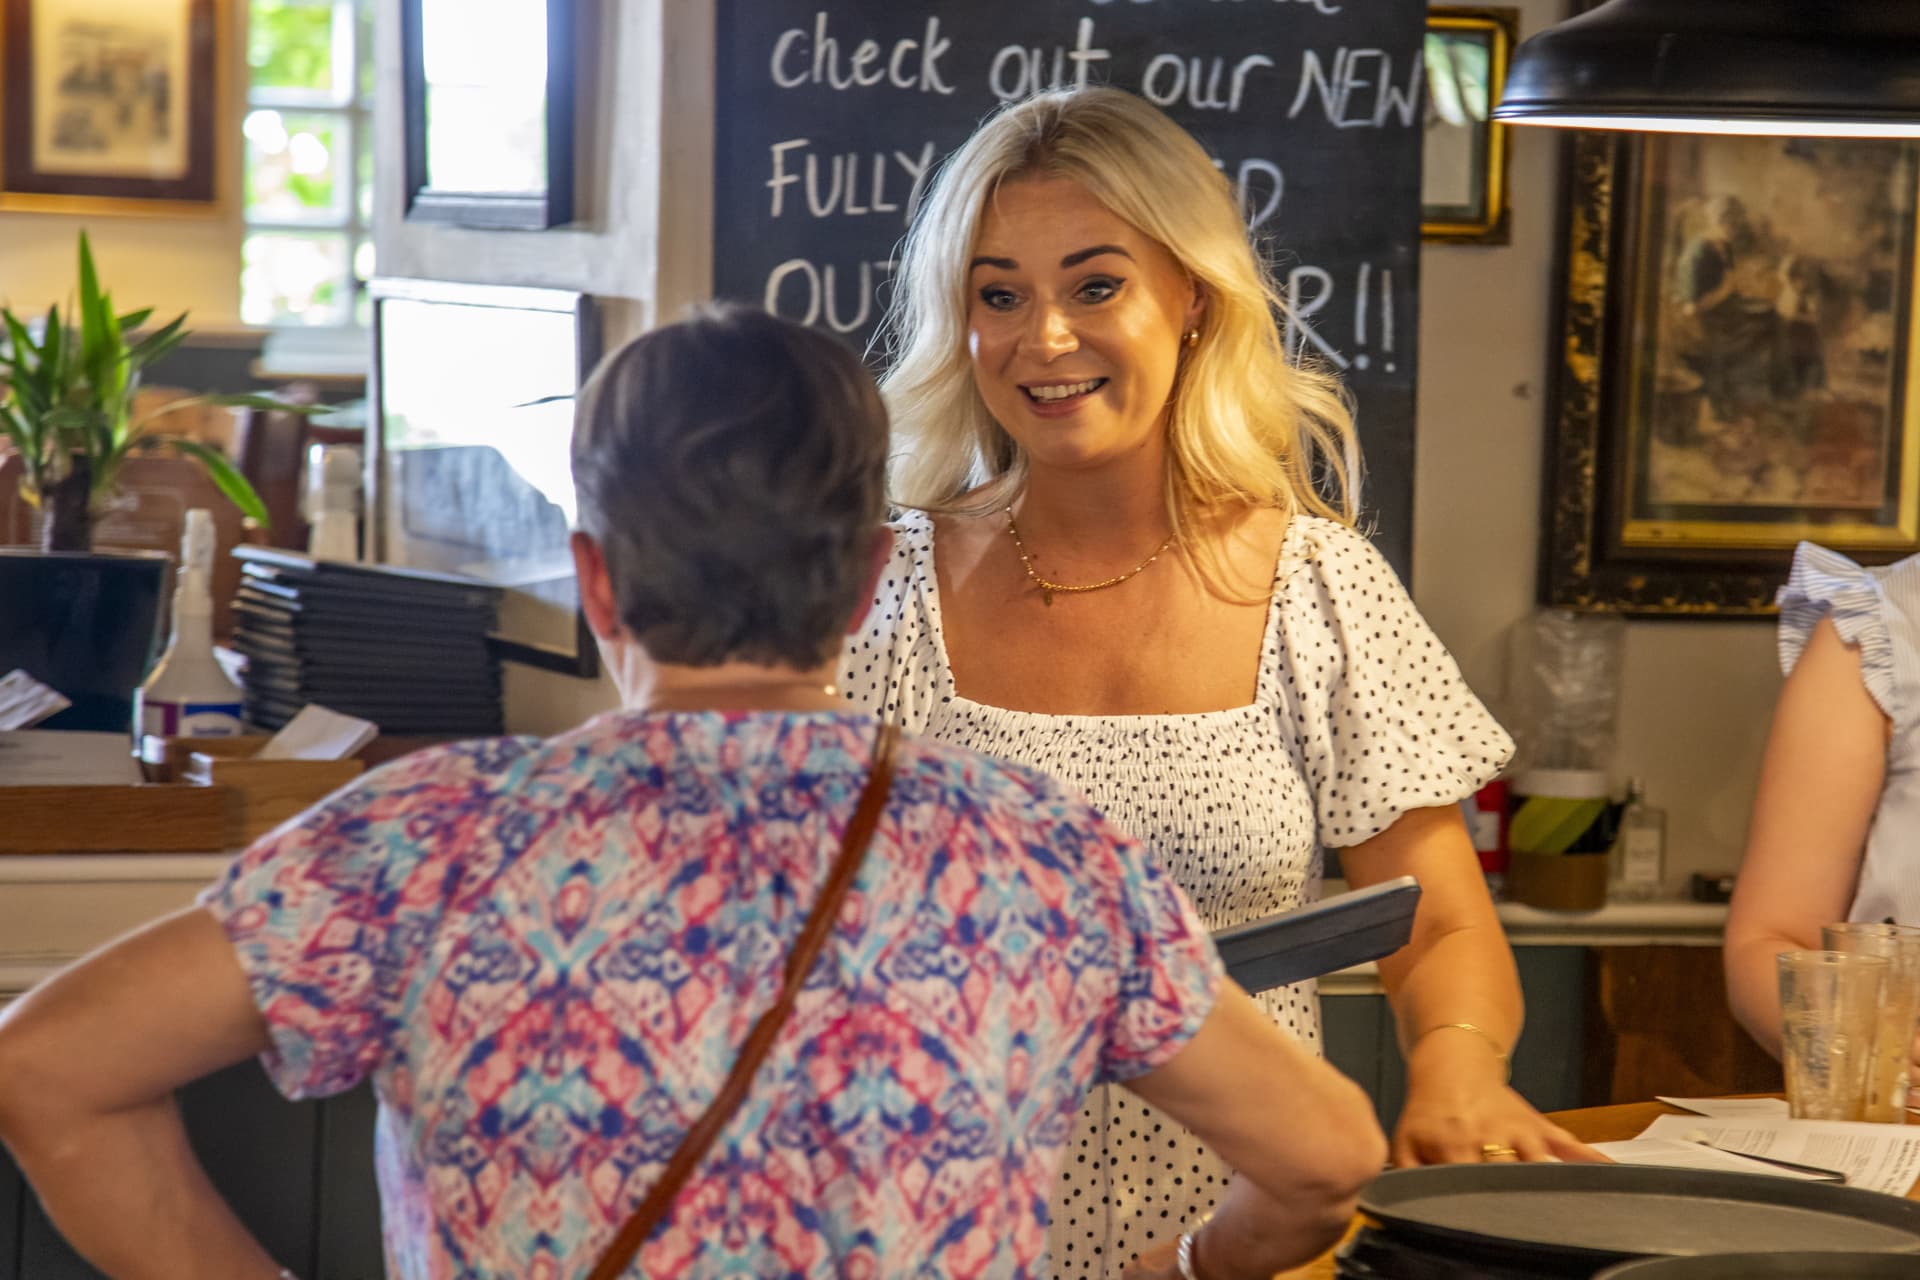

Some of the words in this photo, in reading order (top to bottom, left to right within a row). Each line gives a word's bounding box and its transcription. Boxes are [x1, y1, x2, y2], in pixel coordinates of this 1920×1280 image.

[770, 11, 956, 95] check
[989, 17, 1112, 101] out
[1142, 54, 1275, 113] our
[1287, 47, 1423, 129] NEW
[766, 138, 936, 228] FULLY
